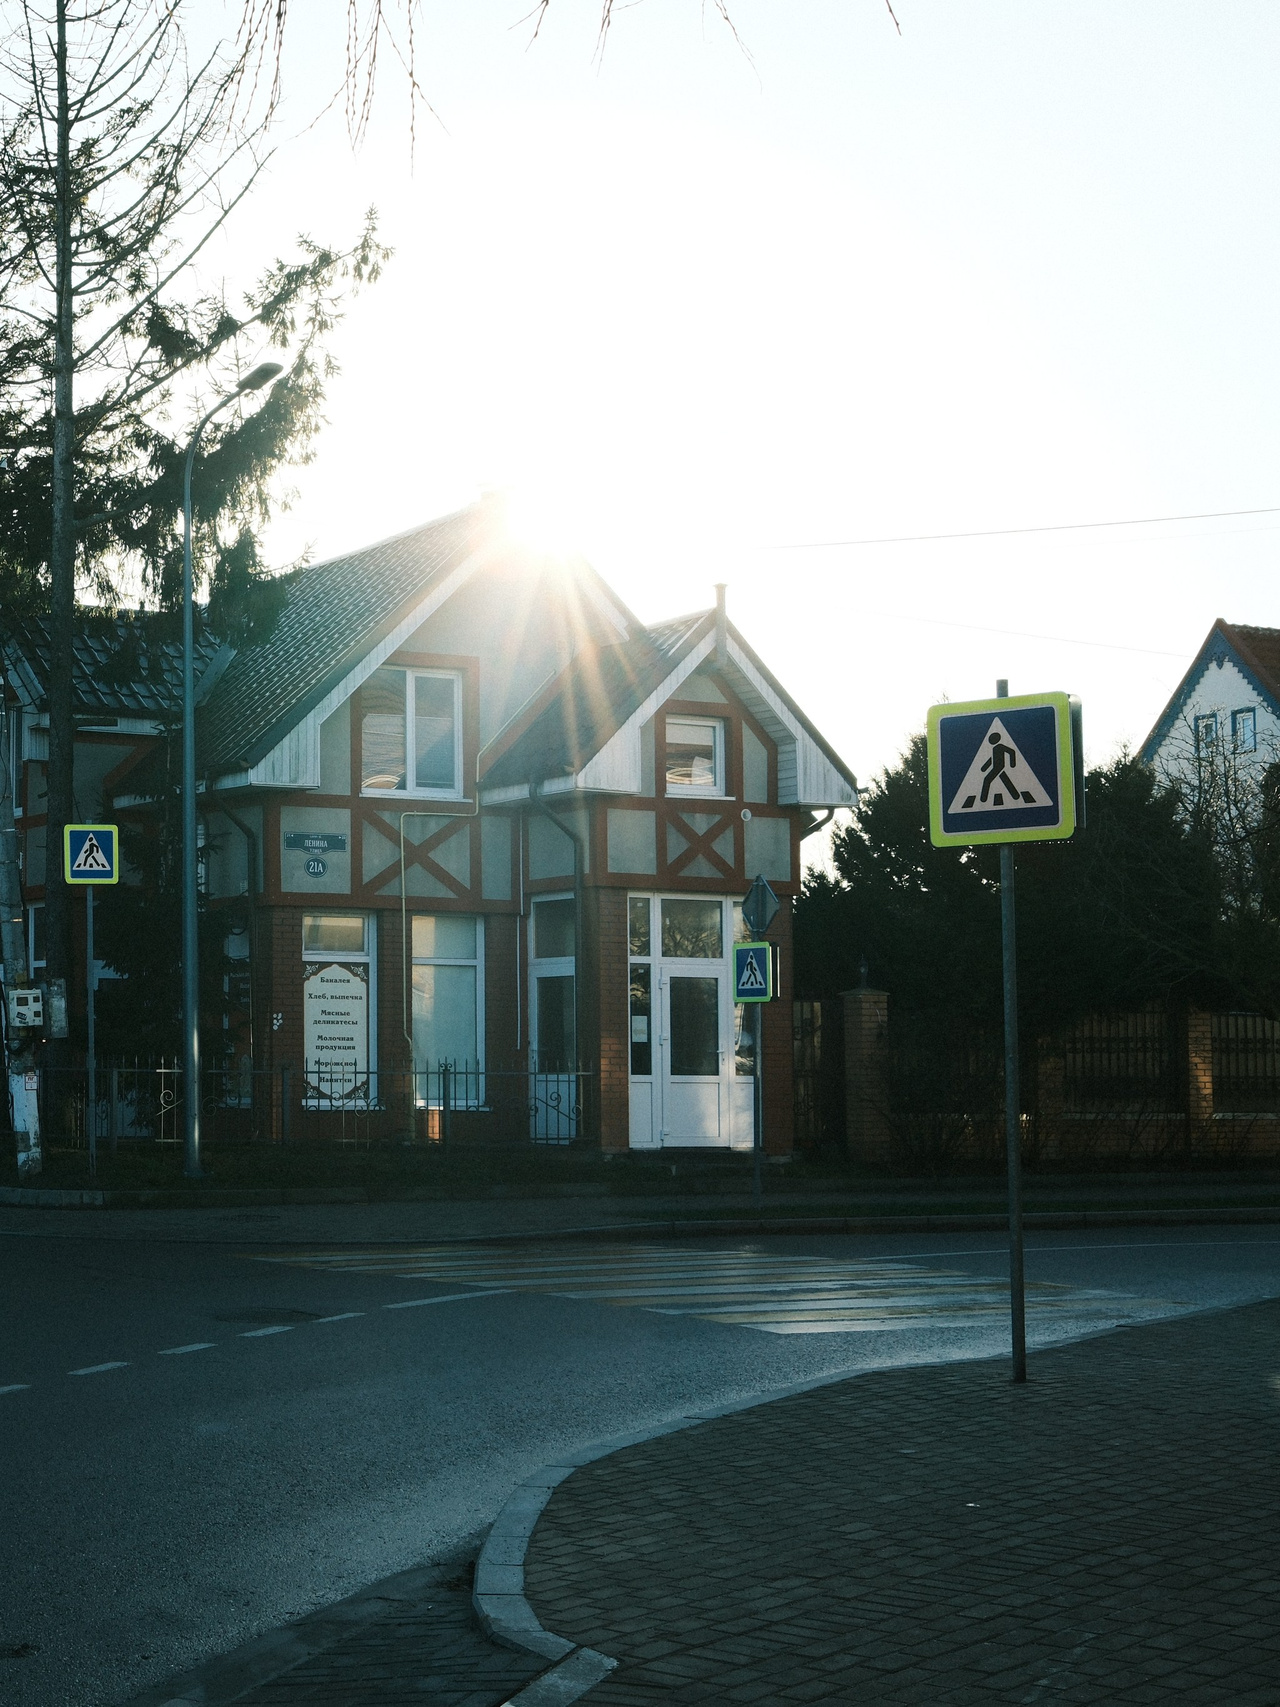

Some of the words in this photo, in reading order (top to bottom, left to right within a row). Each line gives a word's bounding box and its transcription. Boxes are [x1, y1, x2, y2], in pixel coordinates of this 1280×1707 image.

[304, 840, 328, 848] ЛЕНИНА
[309, 861, 324, 873] 21А
[320, 976, 351, 984] Бакалея
[308, 992, 329, 1000] Хлеб,
[316, 1034, 354, 1042] Молочная
[315, 1044, 356, 1052] продукция
